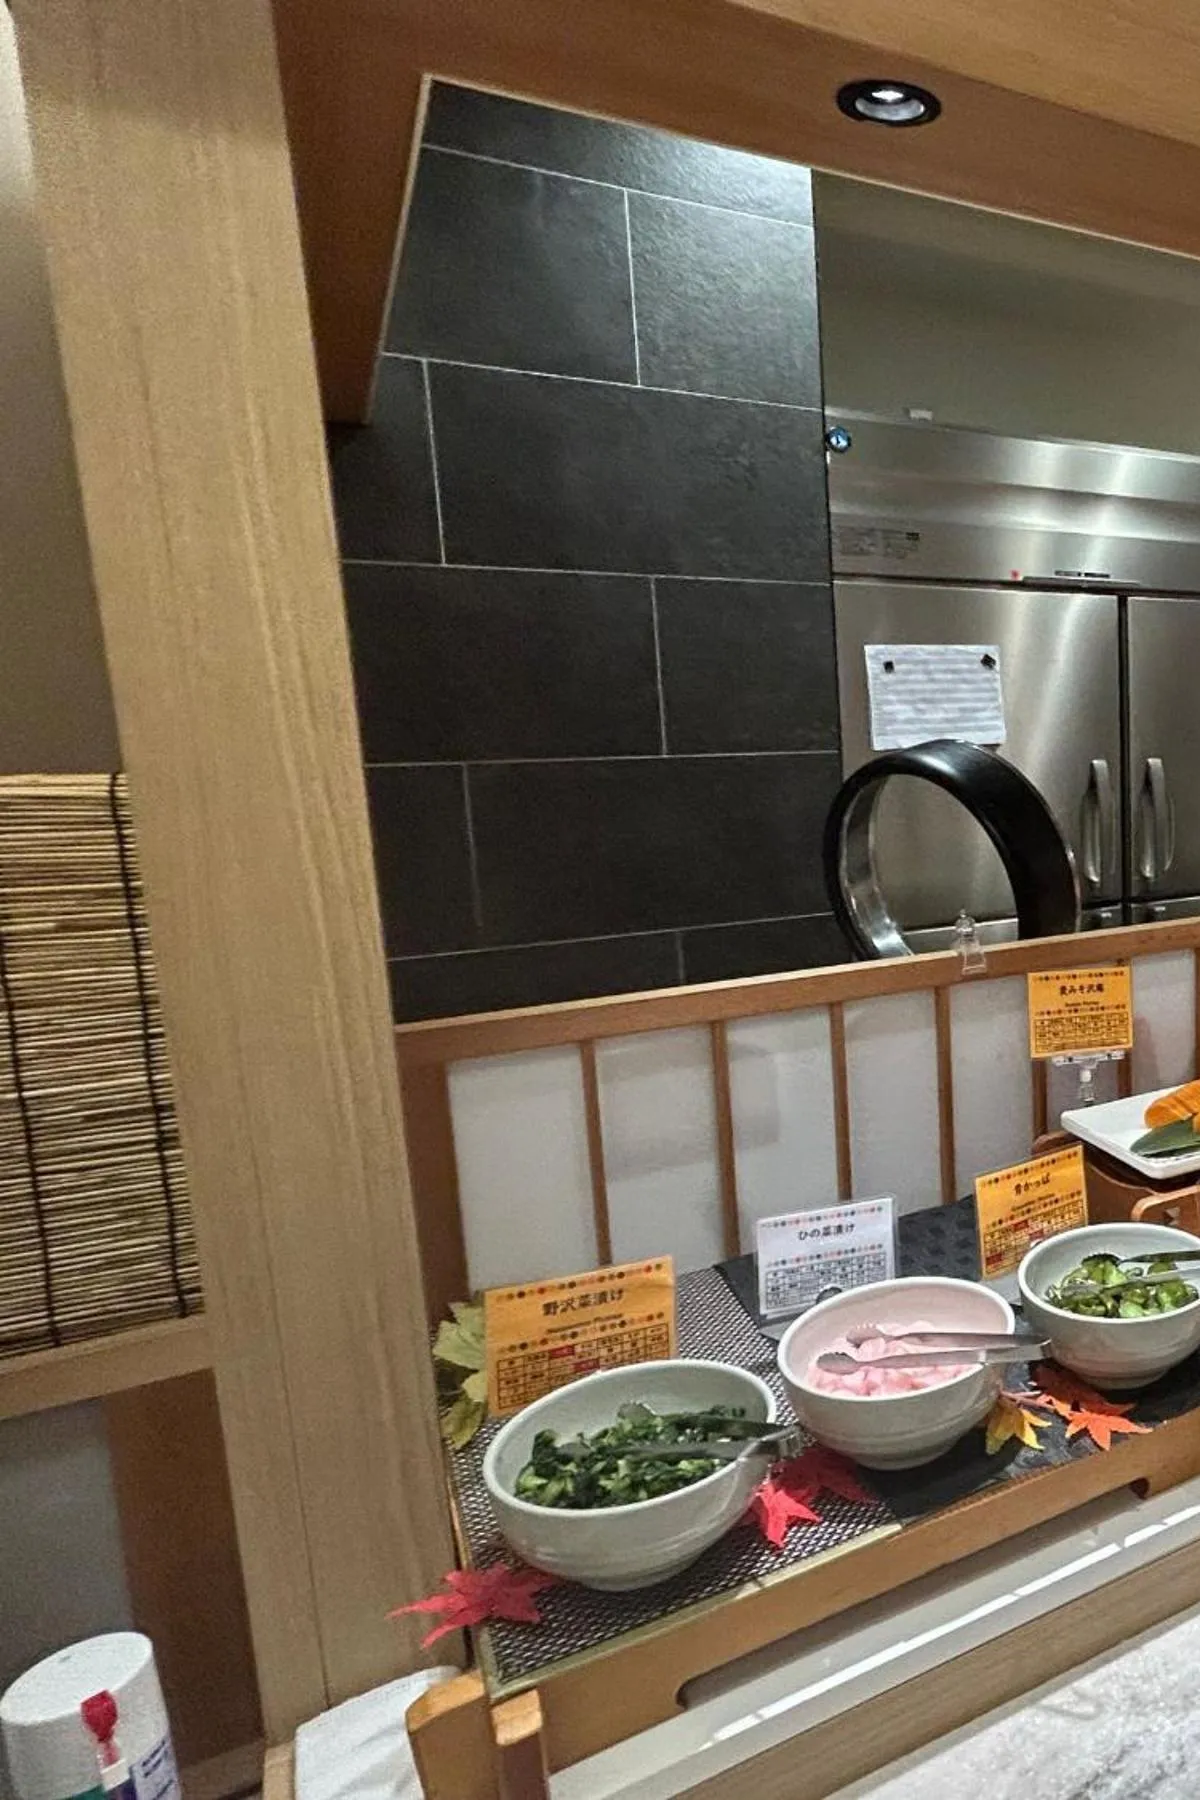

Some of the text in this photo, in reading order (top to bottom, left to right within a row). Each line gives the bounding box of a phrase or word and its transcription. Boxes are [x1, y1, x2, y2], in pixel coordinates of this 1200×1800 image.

[798, 1223, 855, 1241] ひの菜漬け
[542, 1287, 624, 1317] 野沢菜漬け
